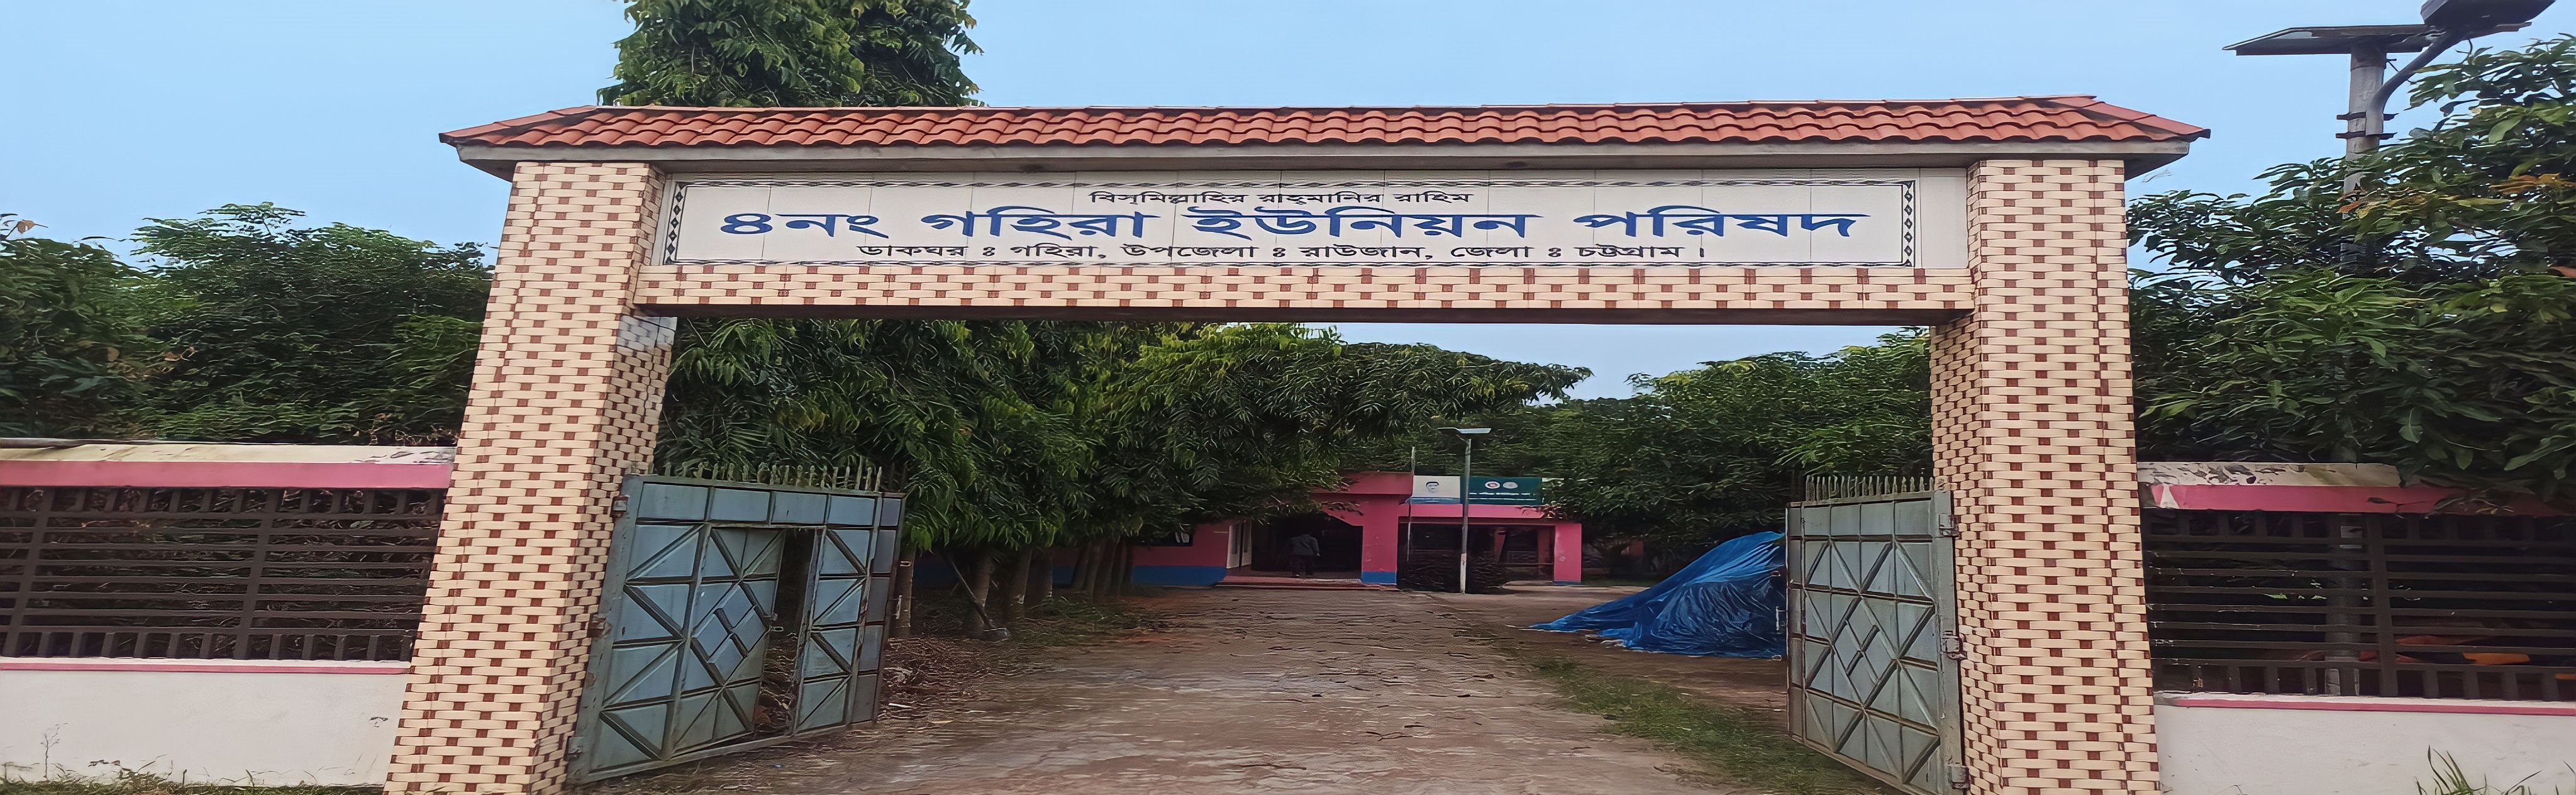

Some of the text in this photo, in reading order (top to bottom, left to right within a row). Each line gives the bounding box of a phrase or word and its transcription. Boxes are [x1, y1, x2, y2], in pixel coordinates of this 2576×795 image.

[1392, 191, 1474, 204] রাহিম
[720, 206, 1871, 240] ৪নং গহিরা ইউনিয়ন পরিষদ
[856, 245, 969, 257] ডাকঘর
[1010, 242, 1107, 259] গহিরা,
[1121, 243, 1259, 258] উপজেলা
[1299, 244, 1434, 260] রাউজান,
[1450, 246, 1535, 258] জেলা
[1574, 244, 1685, 258] চট্টগ্রাম
